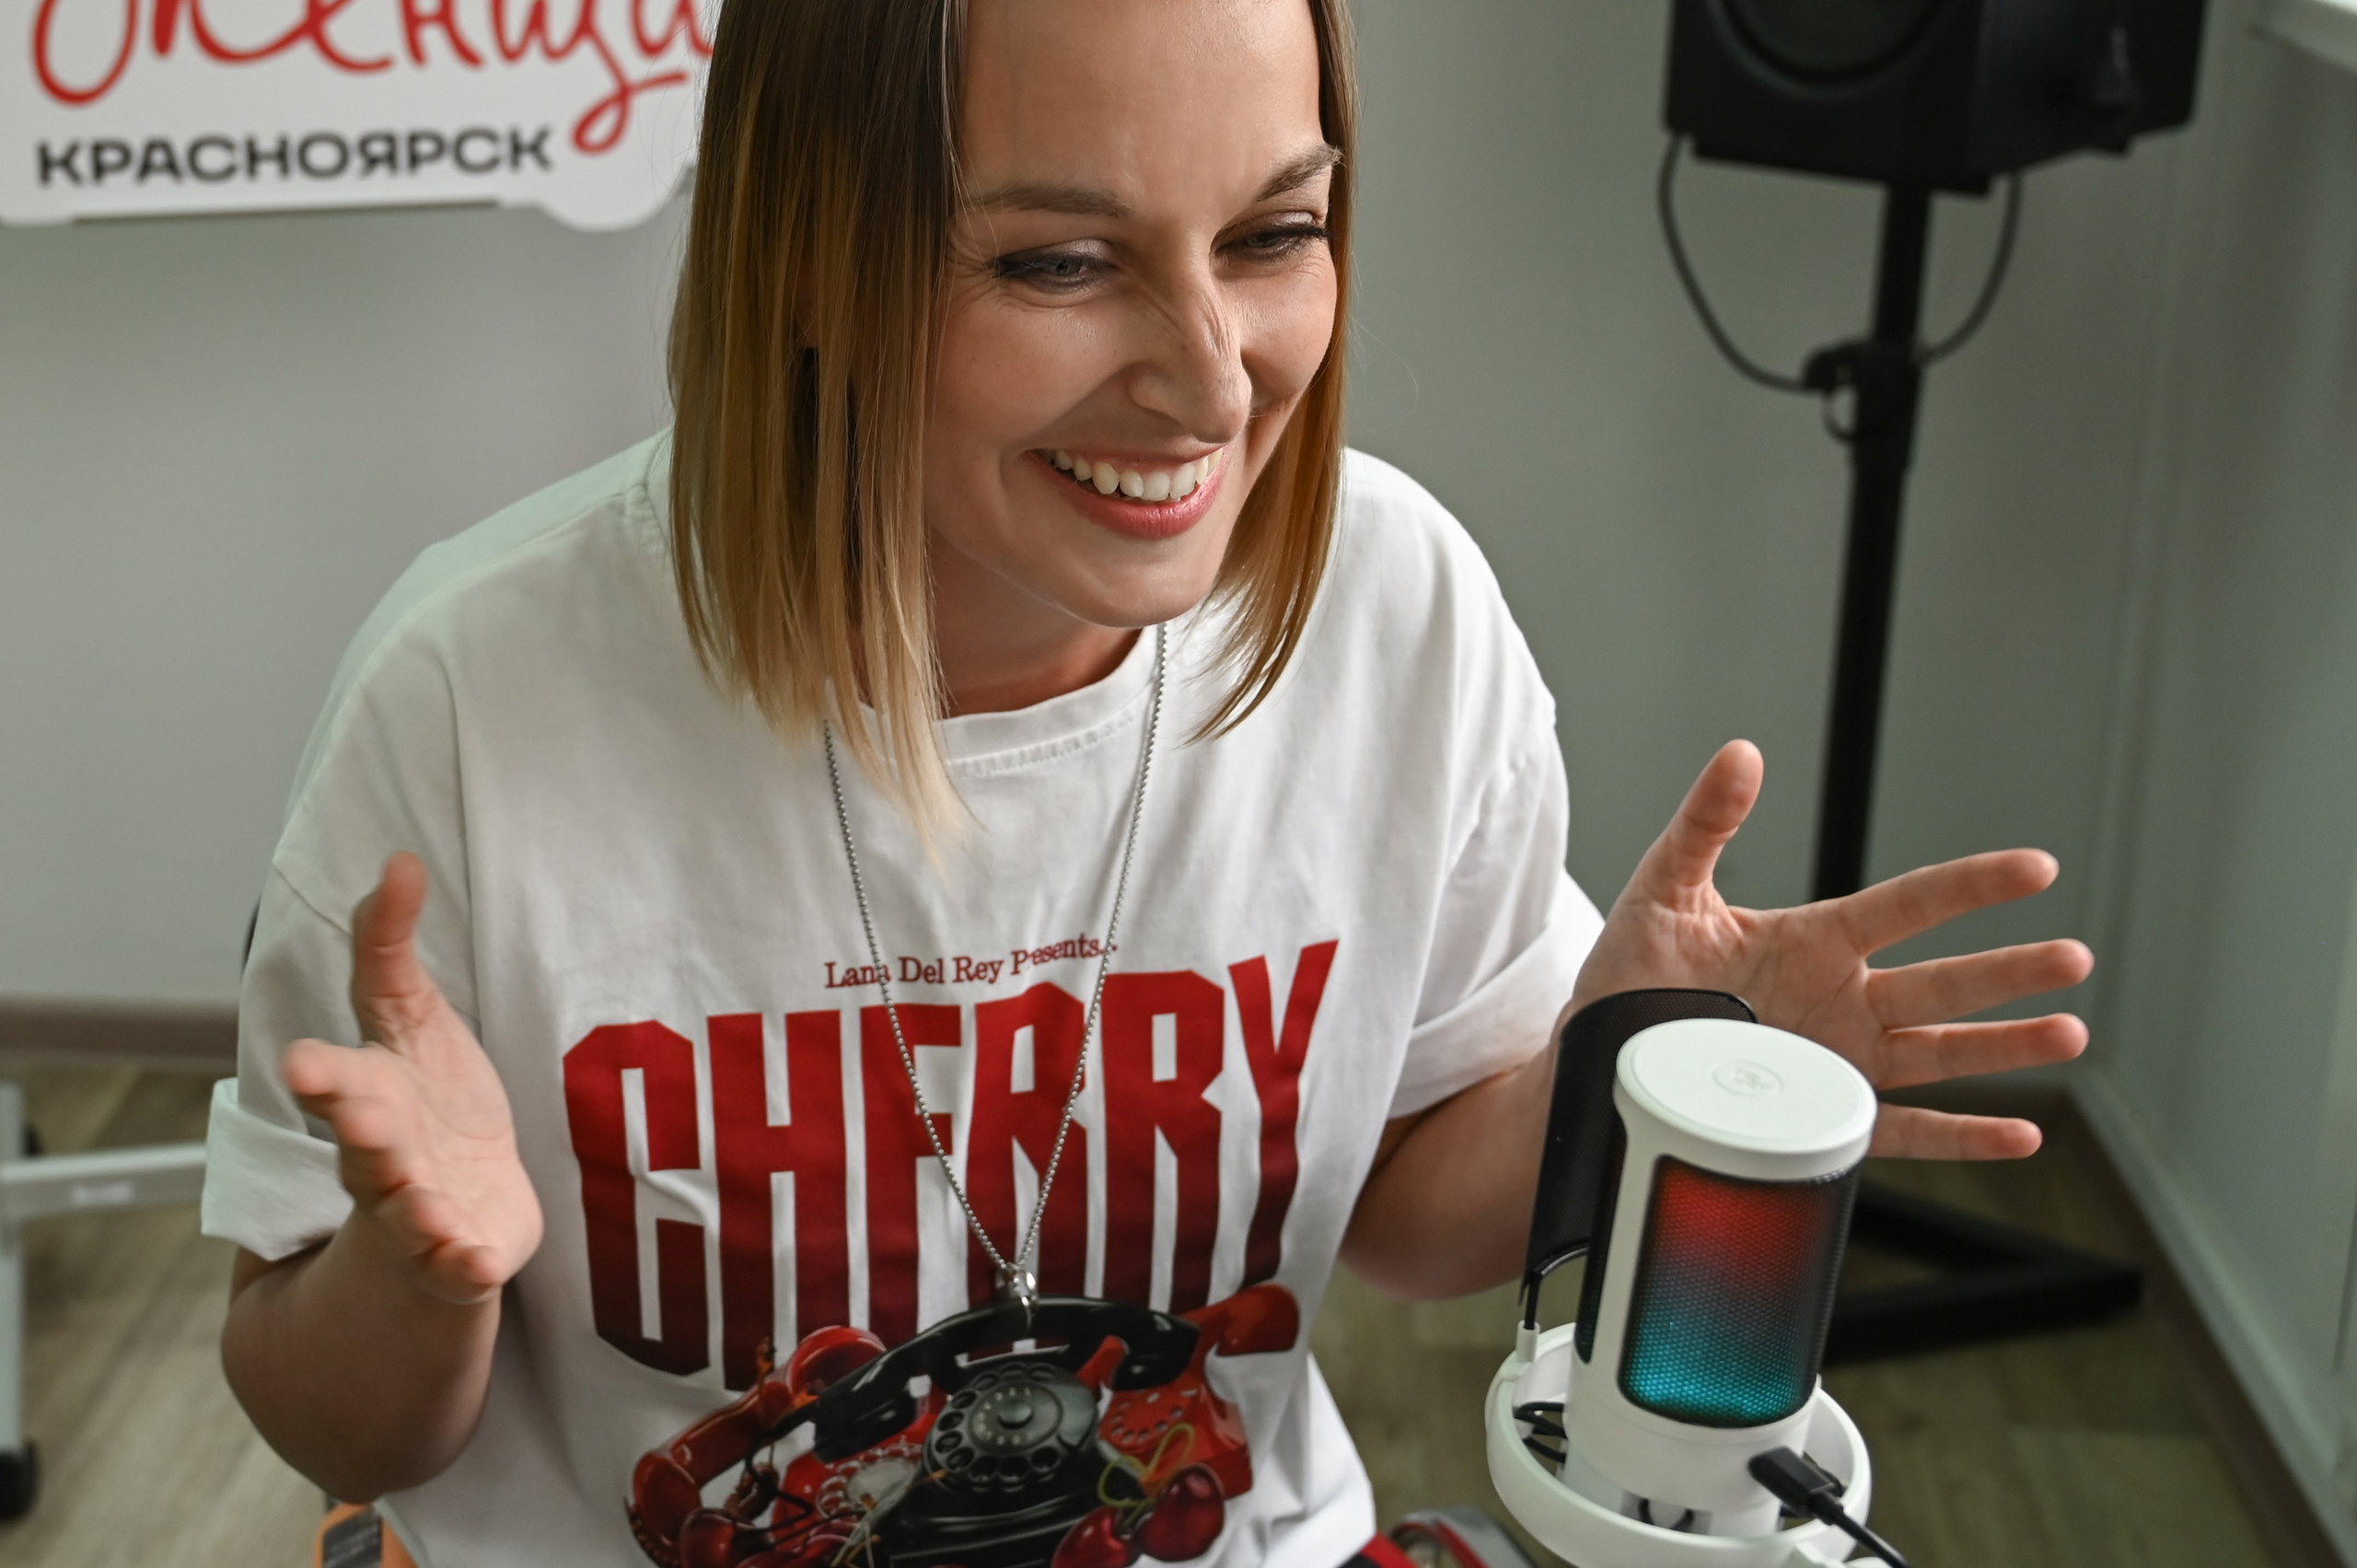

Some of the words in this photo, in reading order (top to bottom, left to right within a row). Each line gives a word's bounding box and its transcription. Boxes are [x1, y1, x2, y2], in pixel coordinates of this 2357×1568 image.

[36, 125, 552, 186] КРАСНОЯРСК
[898, 956, 945, 983] Del
[952, 956, 1004, 983] Rey
[563, 939, 1339, 1392] CHERRY
